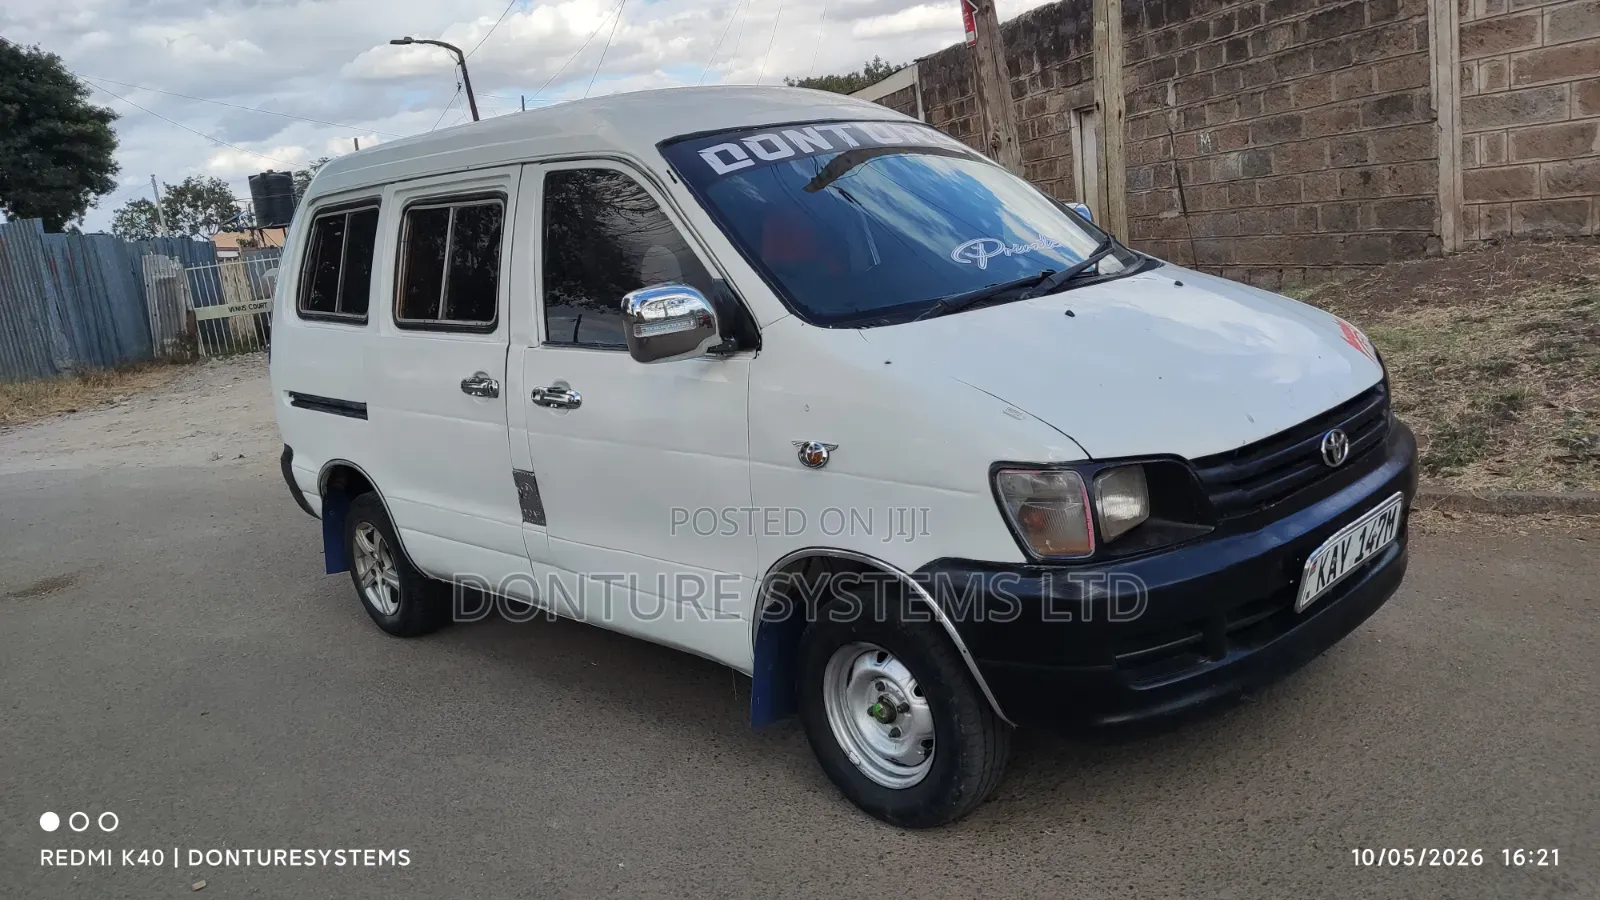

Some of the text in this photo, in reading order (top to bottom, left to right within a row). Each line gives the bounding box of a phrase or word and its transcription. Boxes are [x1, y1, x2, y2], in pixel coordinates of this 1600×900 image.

[698, 122, 946, 176] DONTUR
[228, 302, 268, 313] VENUS COURT
[1316, 505, 1398, 592] KAY 147M
